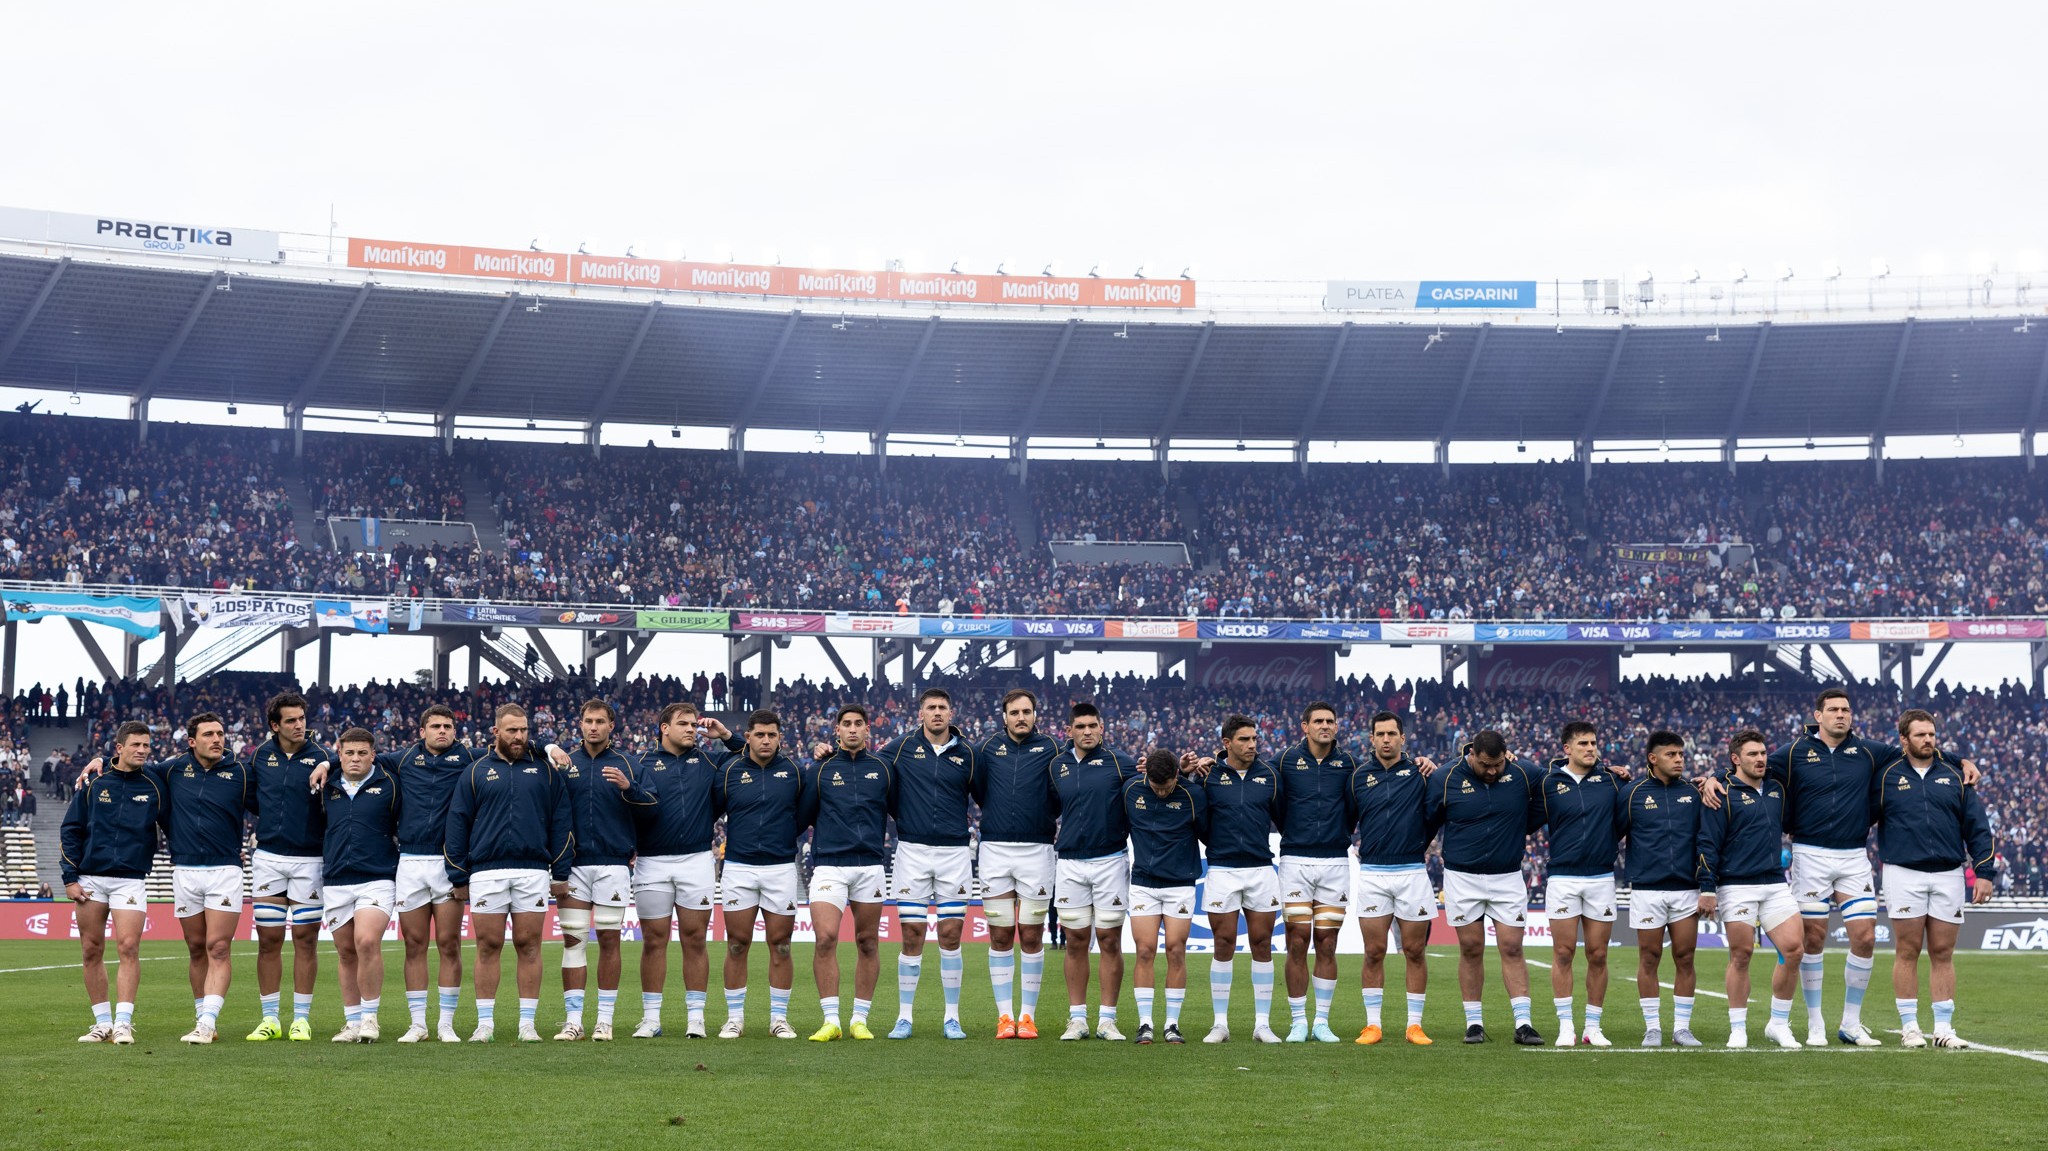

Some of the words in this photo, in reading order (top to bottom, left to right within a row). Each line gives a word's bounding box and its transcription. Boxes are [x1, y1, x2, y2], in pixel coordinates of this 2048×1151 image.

[143, 239, 185, 251] GROUP
[1347, 288, 1404, 300] PLATEA
[1431, 288, 1518, 300] GASPARINI
[215, 600, 247, 613] LOS
[252, 600, 306, 616] PATOS
[477, 607, 497, 615] LATIN
[661, 617, 708, 625] GILBERT
[751, 617, 787, 628] SMS
[852, 620, 893, 631] ESPN
[957, 623, 991, 632] ZURICH
[1025, 622, 1054, 634] VISA
[1064, 622, 1094, 634] VISA
[1141, 624, 1175, 635] Galicia
[1217, 625, 1269, 637] MEDICUS
[1512, 628, 1546, 638] ZURICH
[1580, 627, 1609, 638] VISA
[1621, 627, 1650, 638] VISA
[1775, 626, 1830, 638] MEDICUS
[1968, 624, 2007, 635] SMS
[486, 774, 500, 782] VISA
[1060, 770, 1070, 778] VISA
[1366, 779, 1379, 787] VISA
[1557, 786, 1571, 795] VISA
